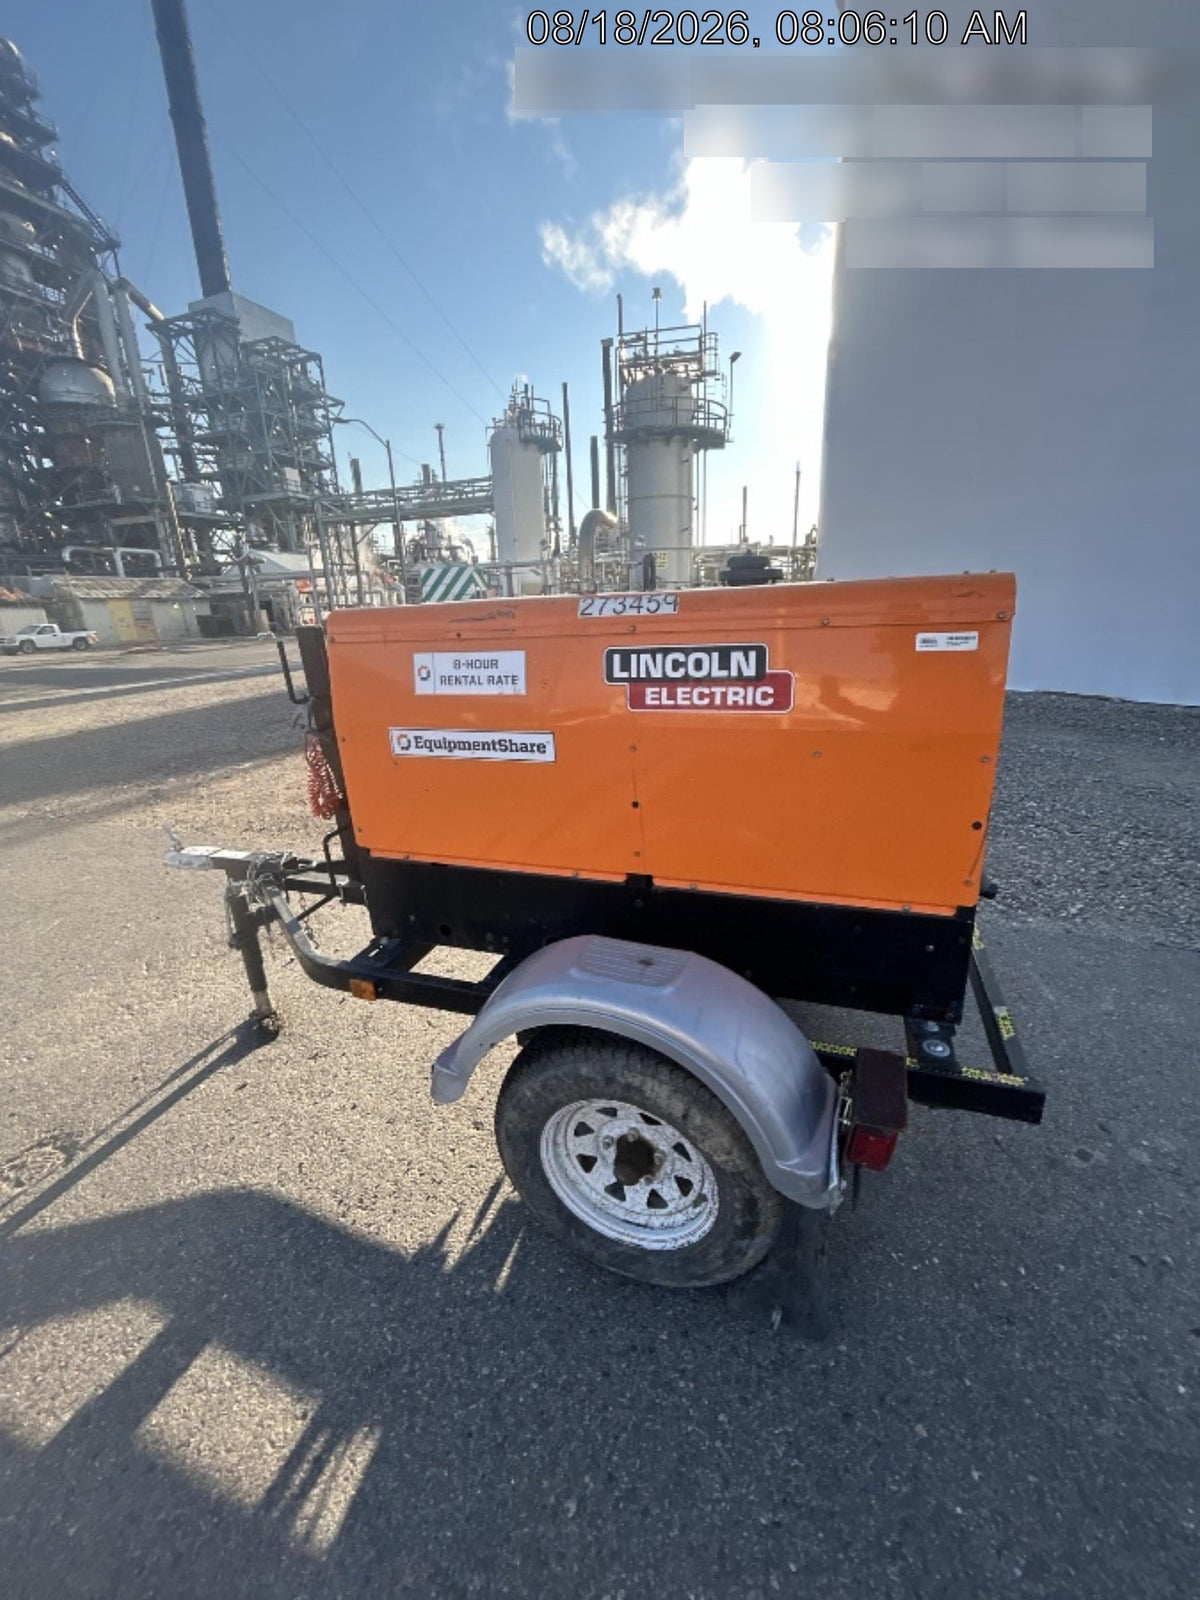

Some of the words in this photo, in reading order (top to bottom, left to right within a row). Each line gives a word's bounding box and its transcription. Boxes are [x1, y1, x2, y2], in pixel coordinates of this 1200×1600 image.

[579, 594, 678, 616] 273459
[453, 659, 499, 670] 8-HOUR
[612, 651, 757, 679] LINCOLN
[440, 675, 484, 686] RENTAL
[487, 674, 519, 686] RATE
[645, 686, 775, 706] ELECTRIC
[414, 735, 547, 755] EquipmentShare
